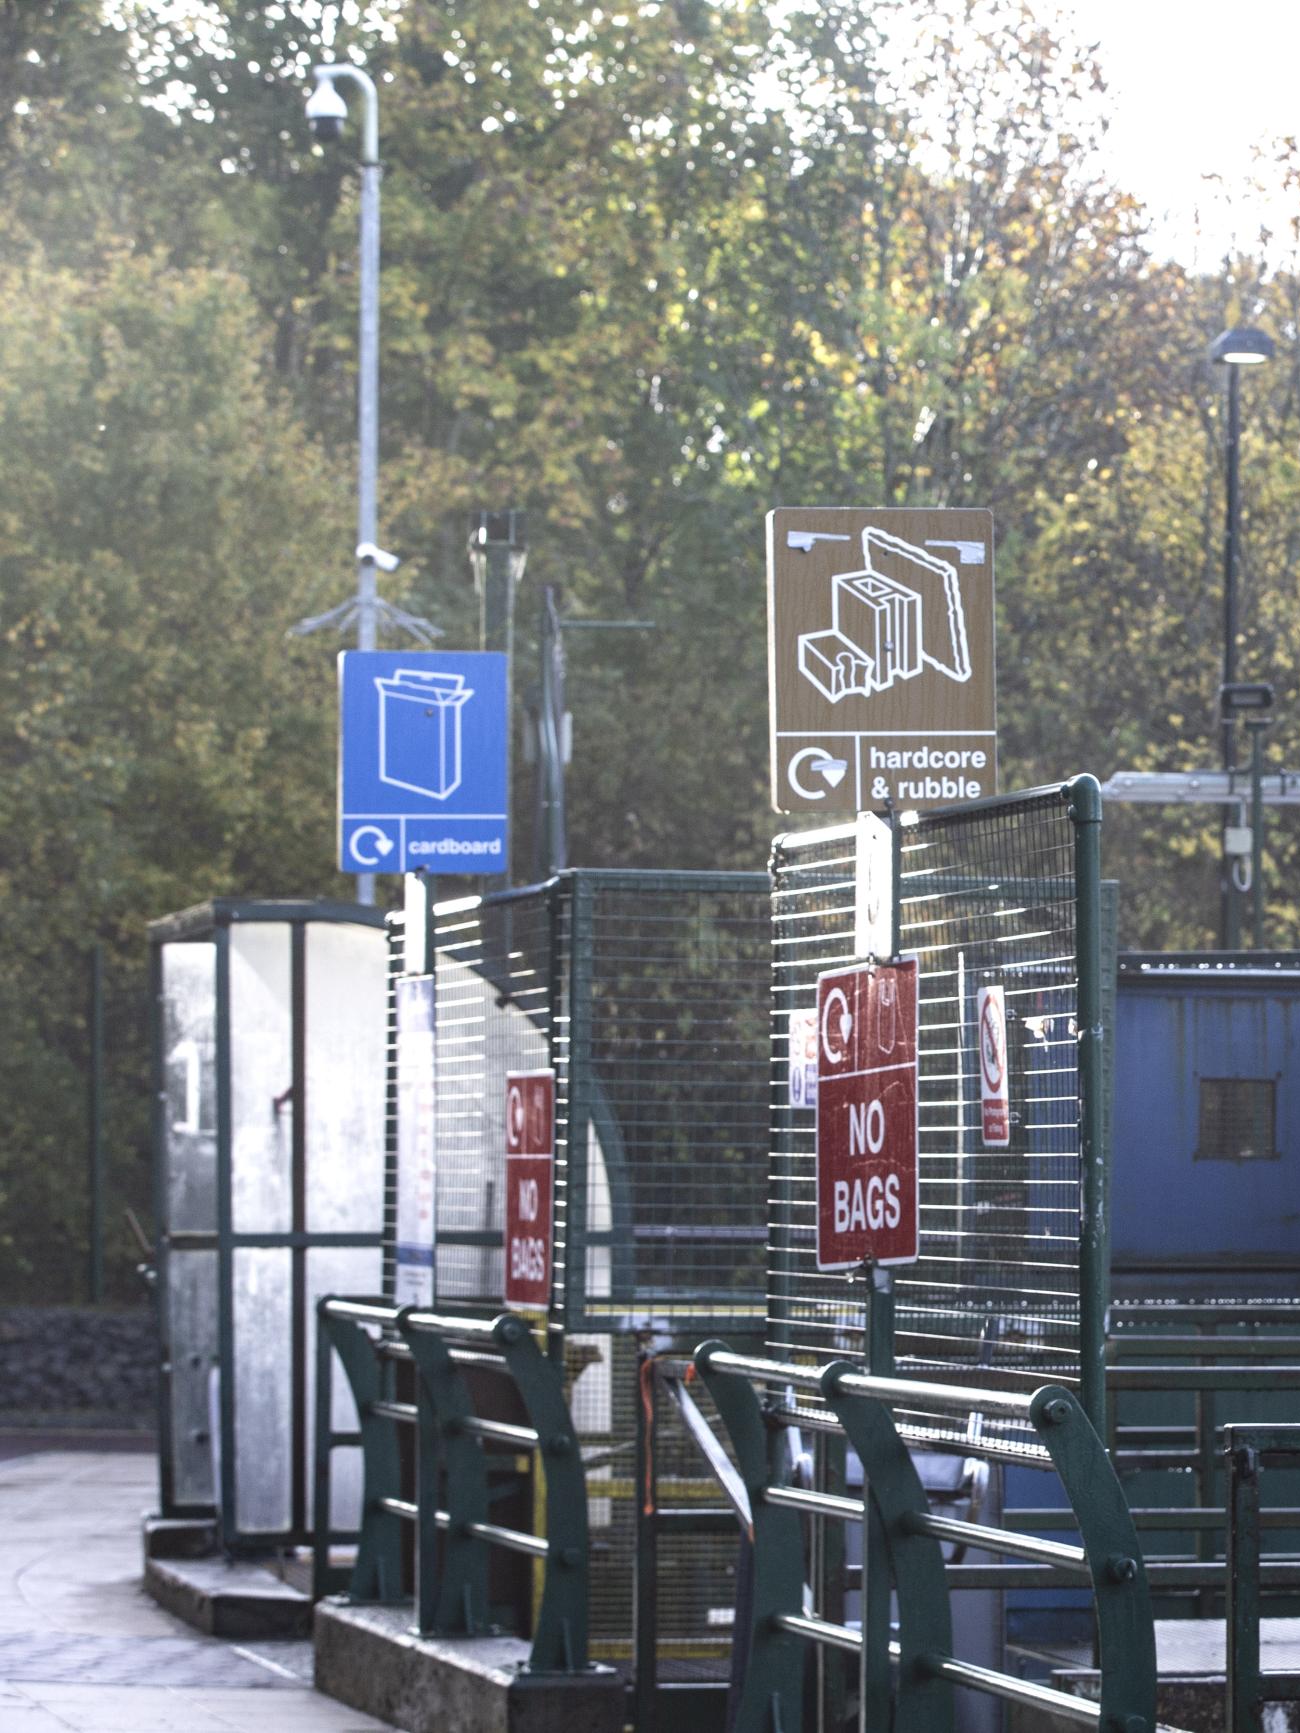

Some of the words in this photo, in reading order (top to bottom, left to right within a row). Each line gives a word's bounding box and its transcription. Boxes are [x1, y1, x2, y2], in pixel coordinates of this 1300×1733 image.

[870, 746, 987, 769] hardcore
[871, 776, 890, 799] &
[898, 776, 981, 799] rubble
[408, 837, 502, 855] cardboard
[850, 1099, 885, 1156] NO
[518, 1179, 539, 1221] NO
[834, 1173, 901, 1233] BAGS
[511, 1237, 545, 1281] BAGS
